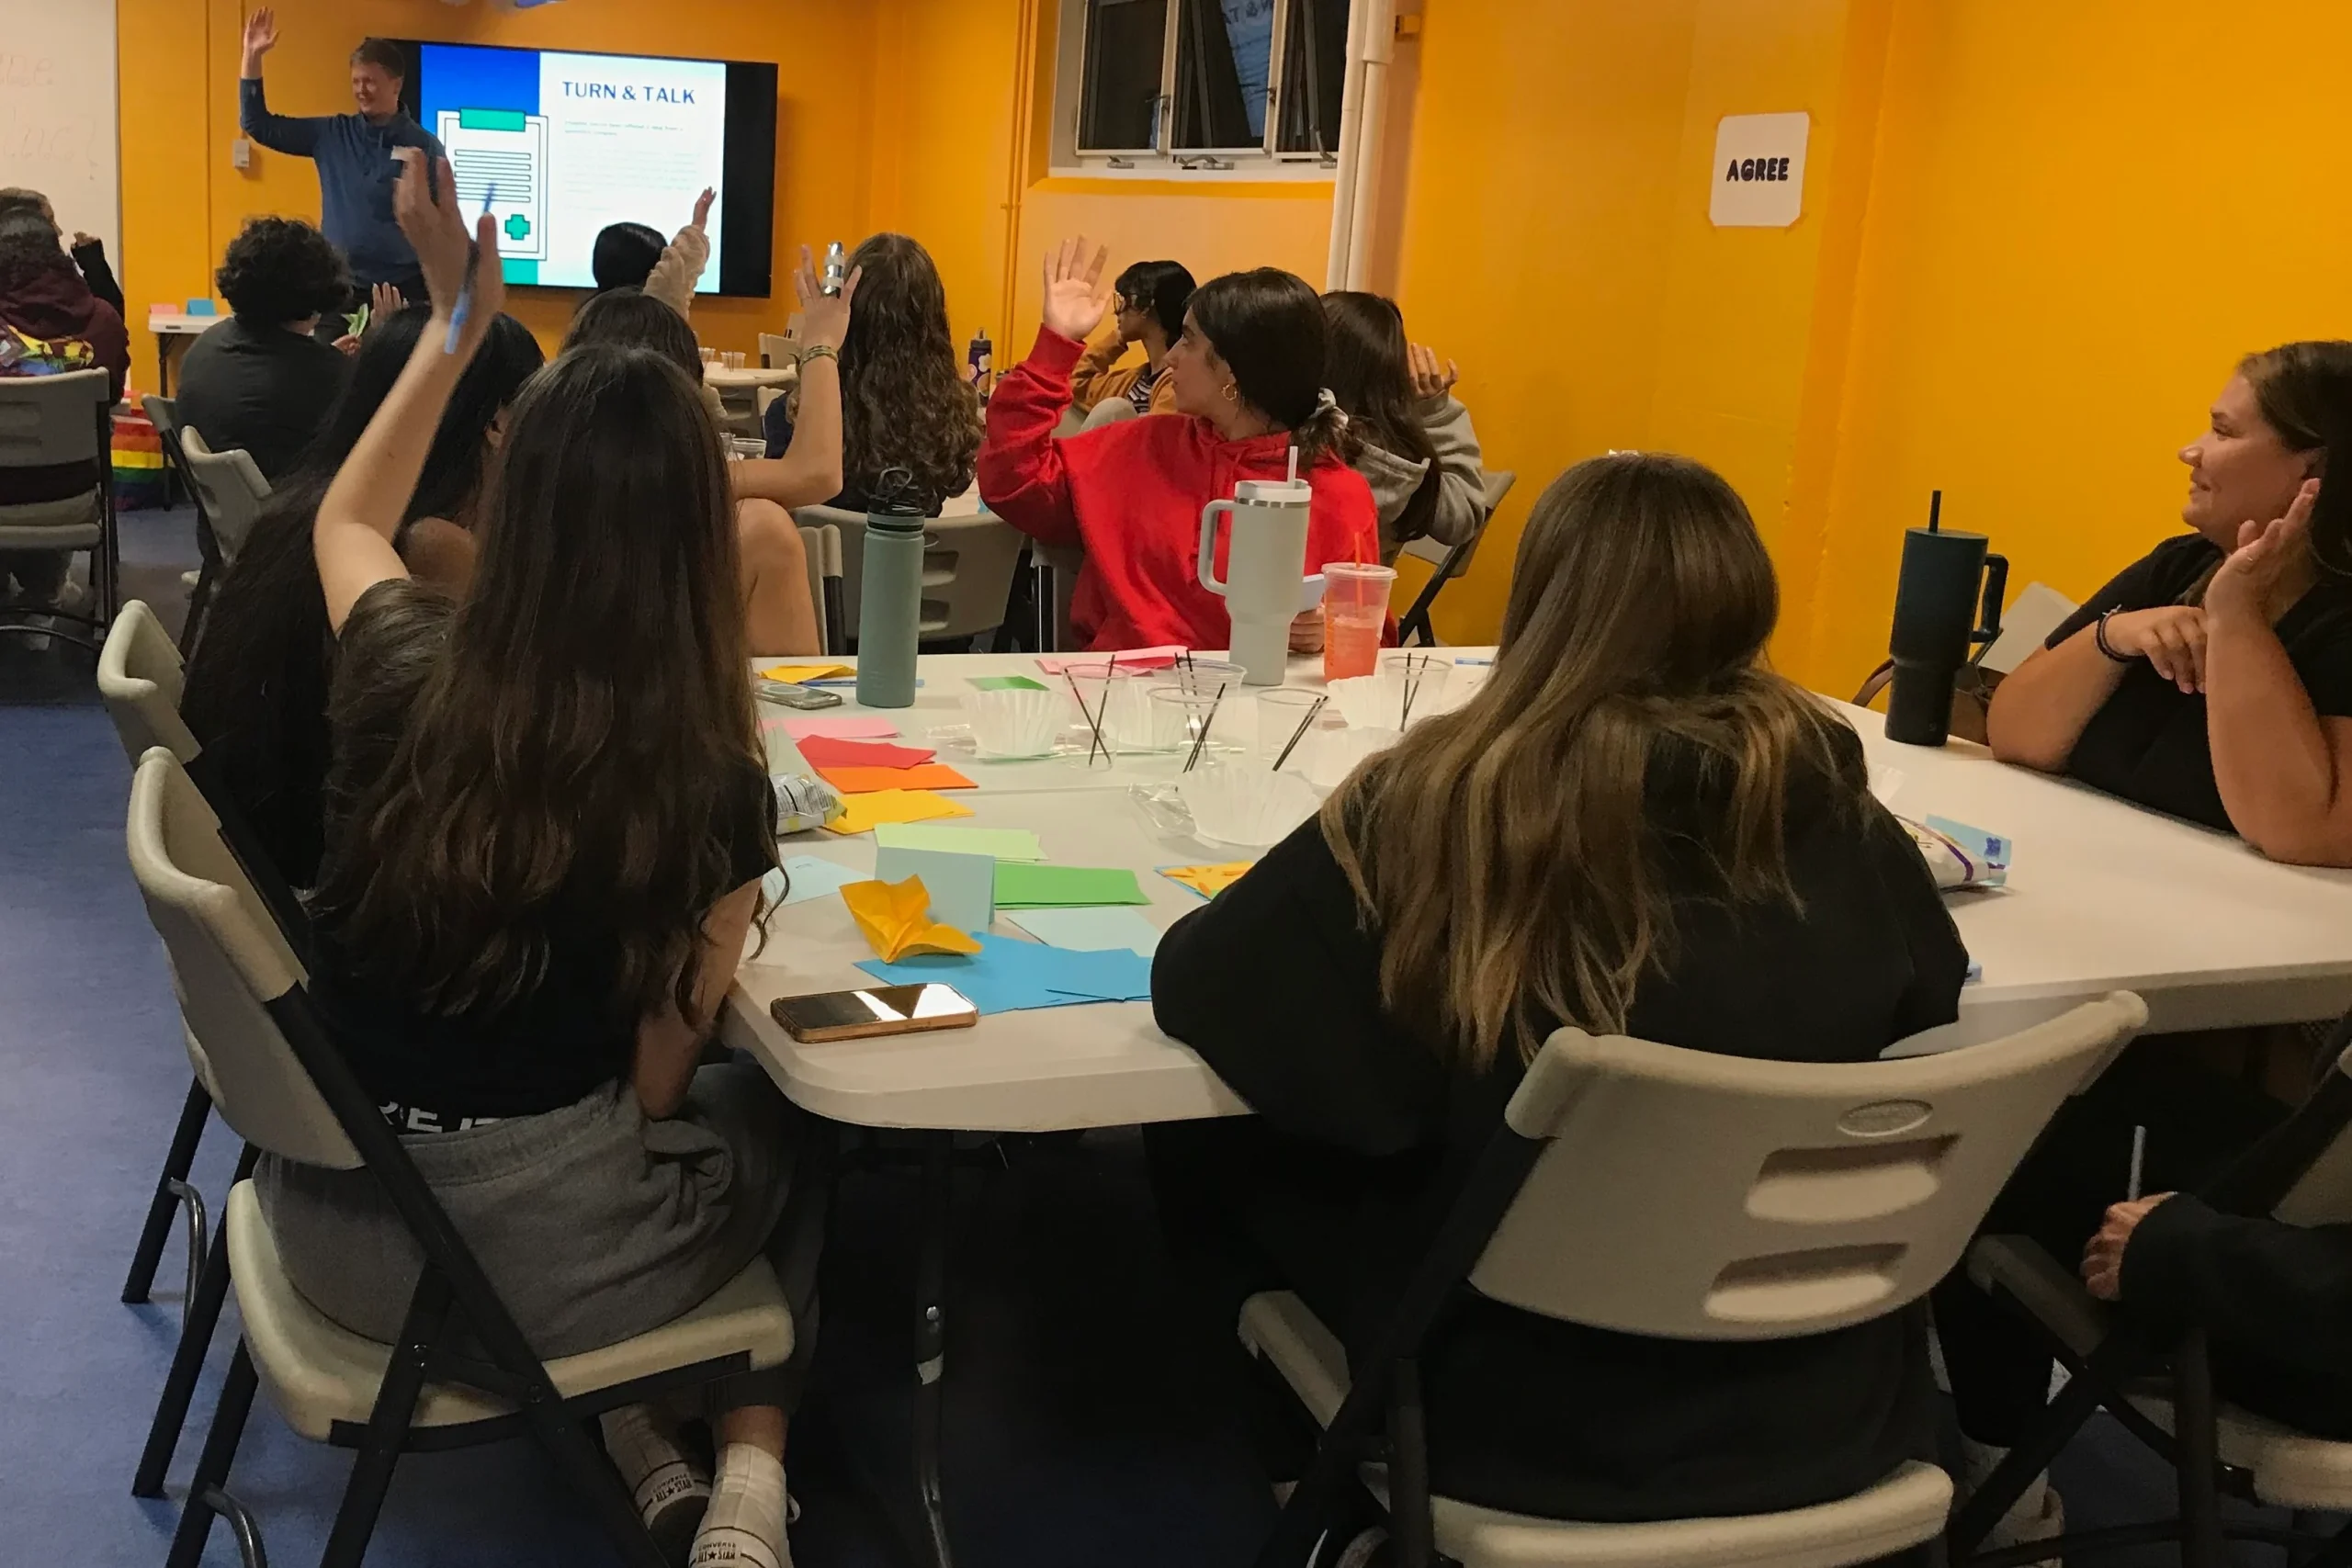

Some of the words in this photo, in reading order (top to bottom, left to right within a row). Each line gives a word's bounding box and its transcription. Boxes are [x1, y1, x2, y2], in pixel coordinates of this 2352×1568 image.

[562, 81, 616, 99] TURN
[622, 85, 637, 100] &
[642, 85, 695, 105] TALK
[1725, 157, 1790, 182] AGREE
